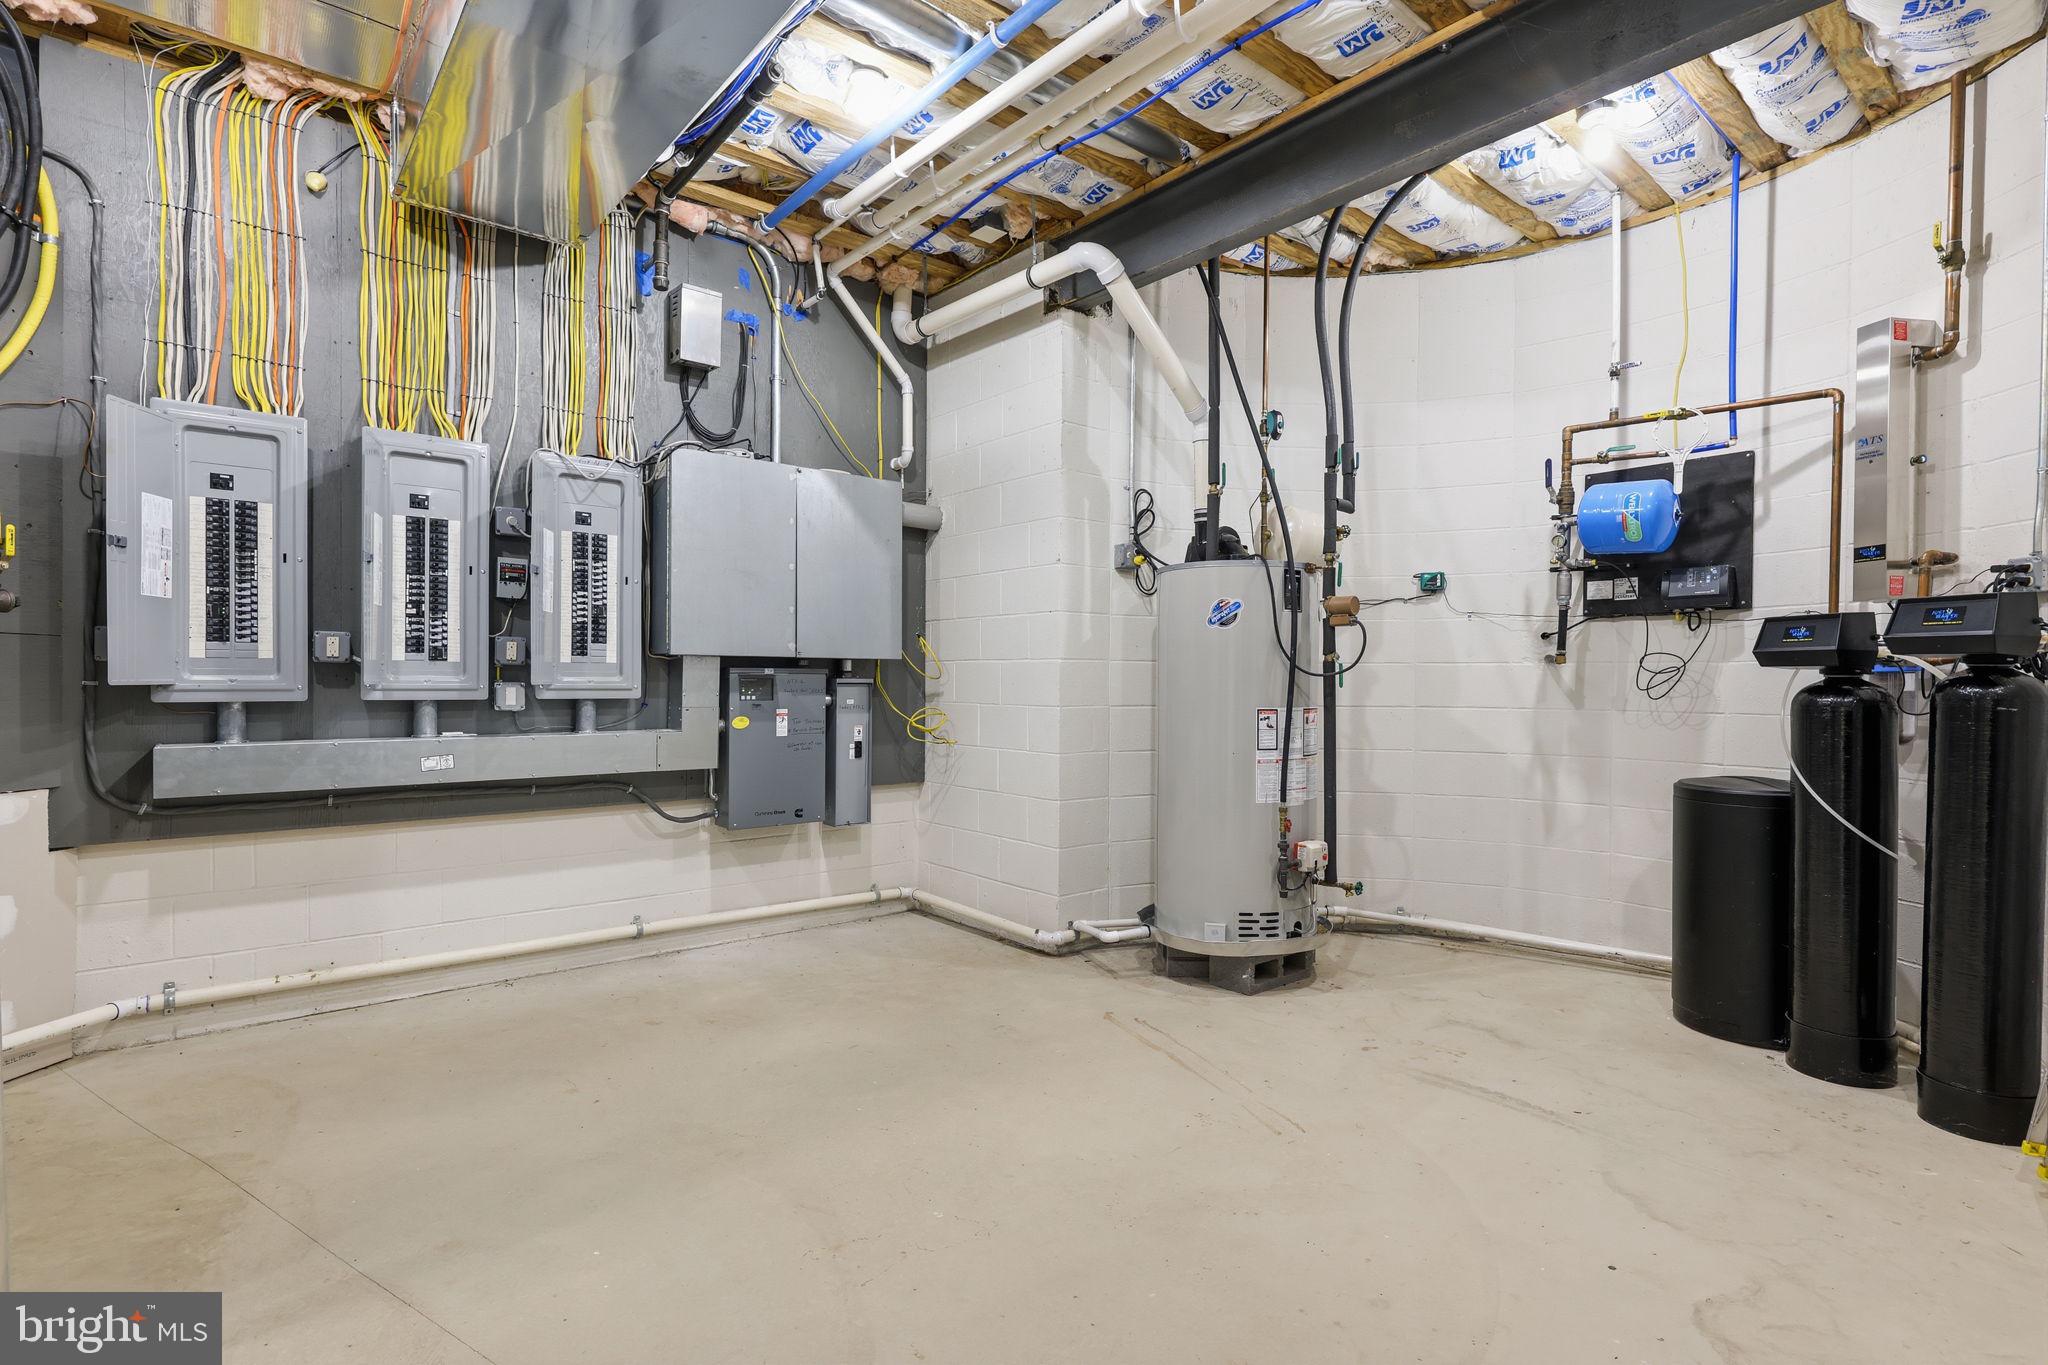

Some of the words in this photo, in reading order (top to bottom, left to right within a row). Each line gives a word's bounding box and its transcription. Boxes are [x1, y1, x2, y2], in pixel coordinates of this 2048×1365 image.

[1336, 23, 1385, 58] JM
[1192, 79, 1235, 110] JM
[789, 119, 823, 154] JM
